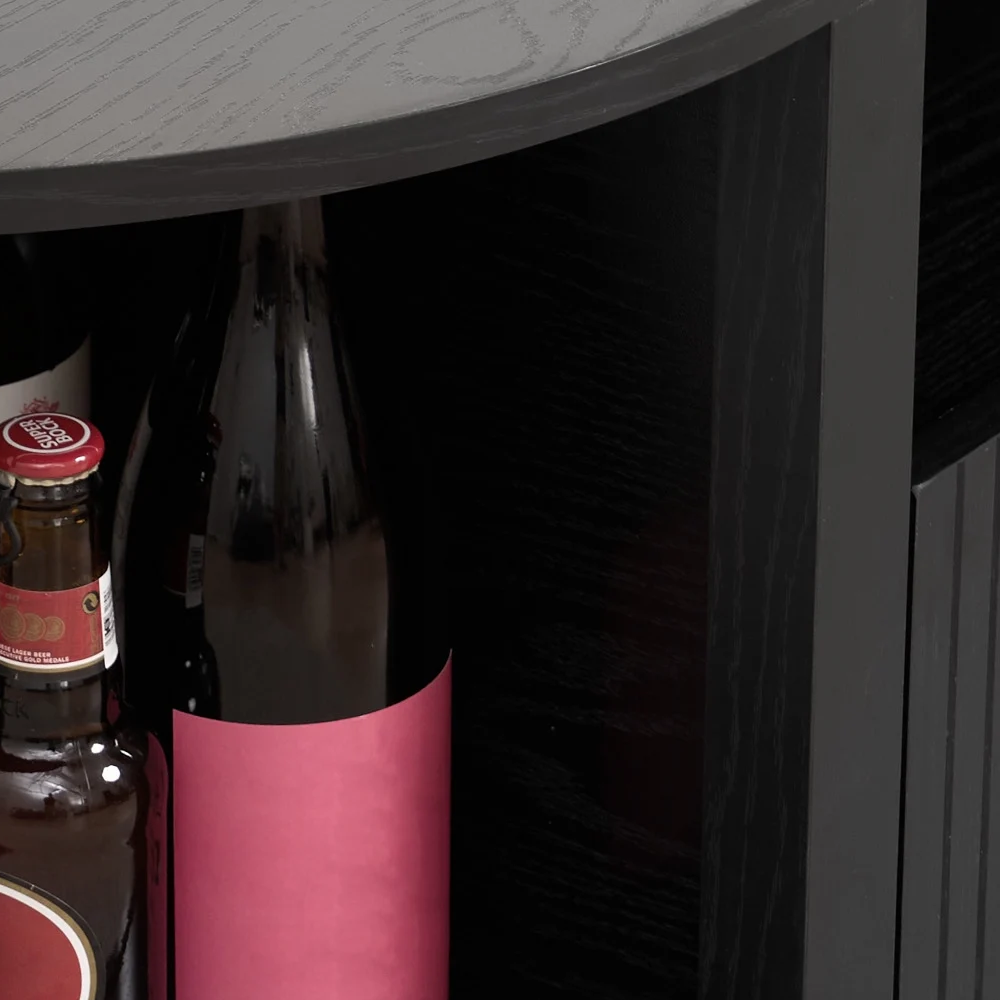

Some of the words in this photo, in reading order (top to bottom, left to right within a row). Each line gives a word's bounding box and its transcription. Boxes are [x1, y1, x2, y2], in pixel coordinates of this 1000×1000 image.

[19, 419, 59, 449] SUPER
[35, 416, 74, 444] BOCK
[12, 647, 32, 656] LAGER
